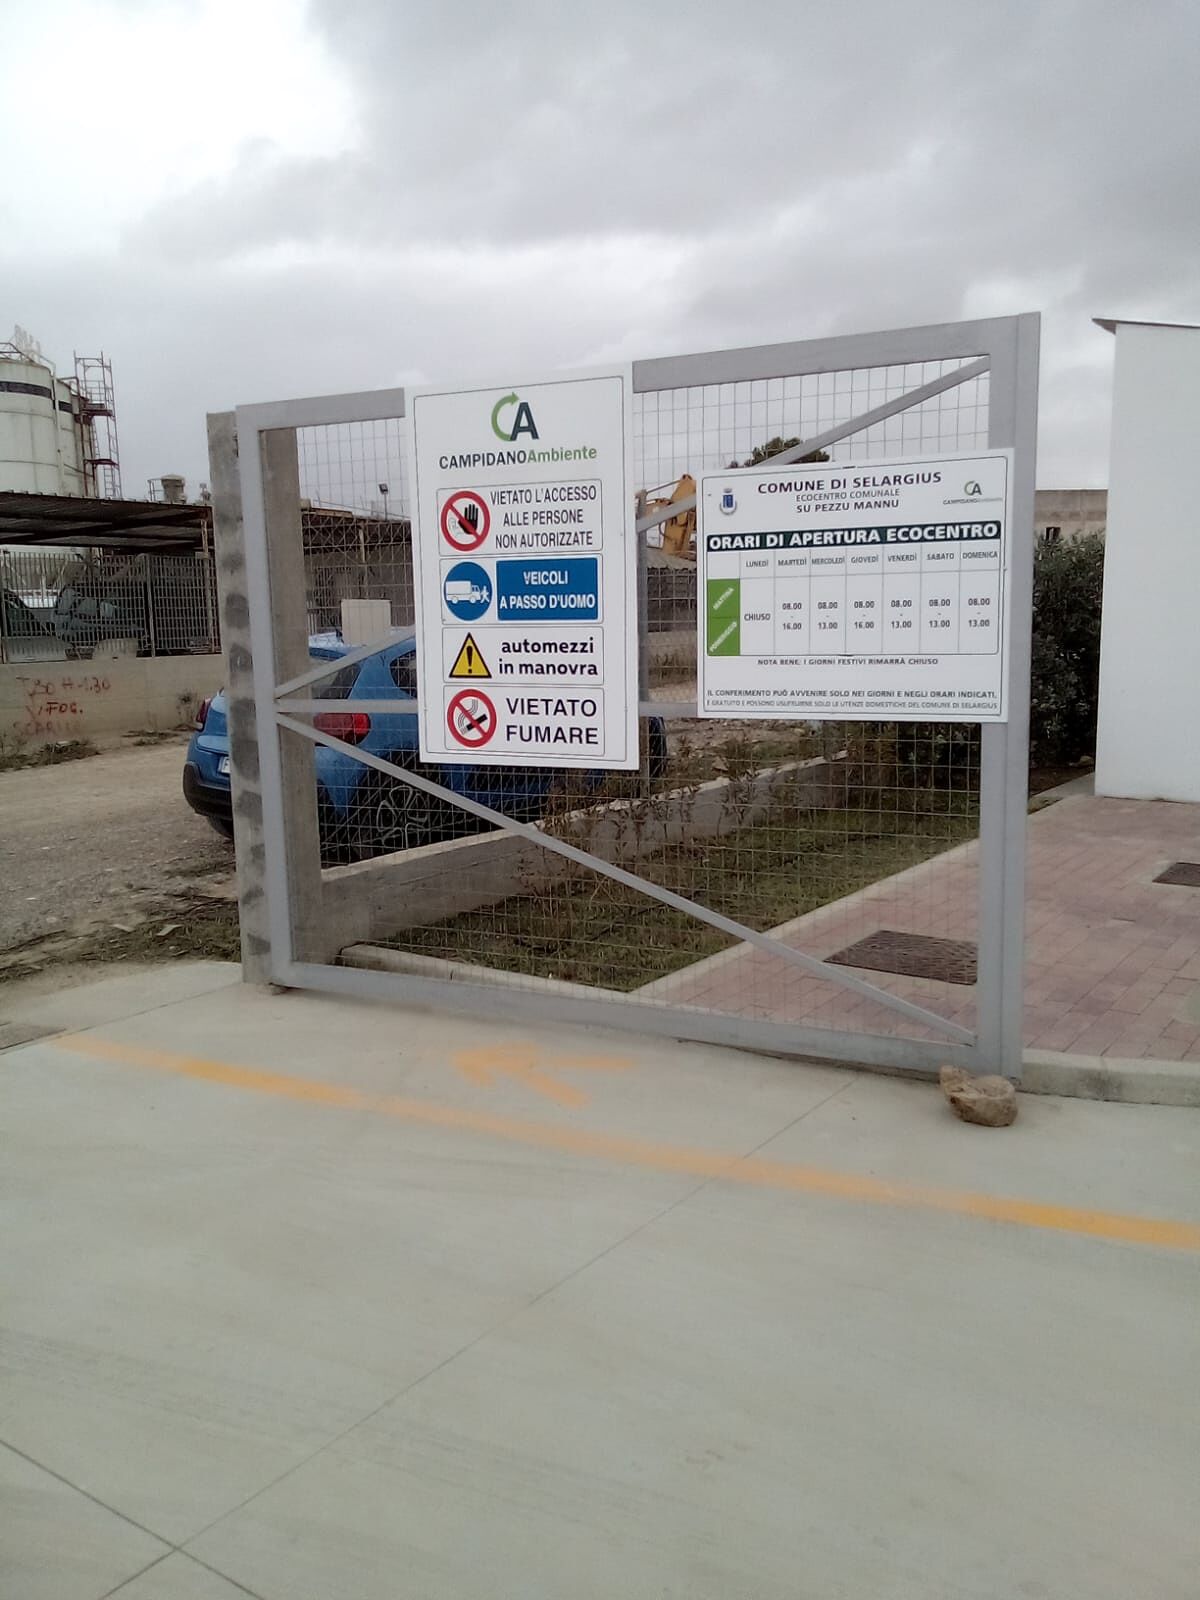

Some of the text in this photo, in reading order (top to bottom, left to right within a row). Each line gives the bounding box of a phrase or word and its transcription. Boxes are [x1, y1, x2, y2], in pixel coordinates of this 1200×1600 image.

[439, 445, 597, 469] CAMPIDANOAmbiente
[758, 472, 942, 494] COMUNE DI SELARGIUS
[490, 485, 597, 505] VIETATO L'ACCESSO
[796, 488, 900, 502] ECOCENTRO COMUNALE
[796, 500, 899, 513] SU PEZZU MANNU
[503, 509, 584, 527] ALLE PERSONE
[495, 531, 593, 549] NON AUTORIZZATE
[709, 523, 998, 550] ORARI DI APERTURA ECOCENTRO
[927, 552, 955, 561] SABATO
[962, 551, 998, 560] DOMENICA
[523, 570, 569, 585] VEICOLI
[500, 594, 596, 609] A PASSO D'UOMO
[782, 598, 990, 610] 08.00 08.00 08.00 08.00 08.00 08.00
[744, 613, 771, 621] CHIUSO
[782, 619, 990, 630] 16.00 13.00 16.00 13.00 13.00 13.00
[501, 637, 594, 654] automezzi
[499, 658, 598, 676] in manovra
[851, 690, 865, 698] NEI
[866, 690, 895, 698] GIORNI
[904, 690, 928, 698] NEGLI
[506, 698, 597, 717] VIETATO
[506, 725, 599, 745] FUMARE
